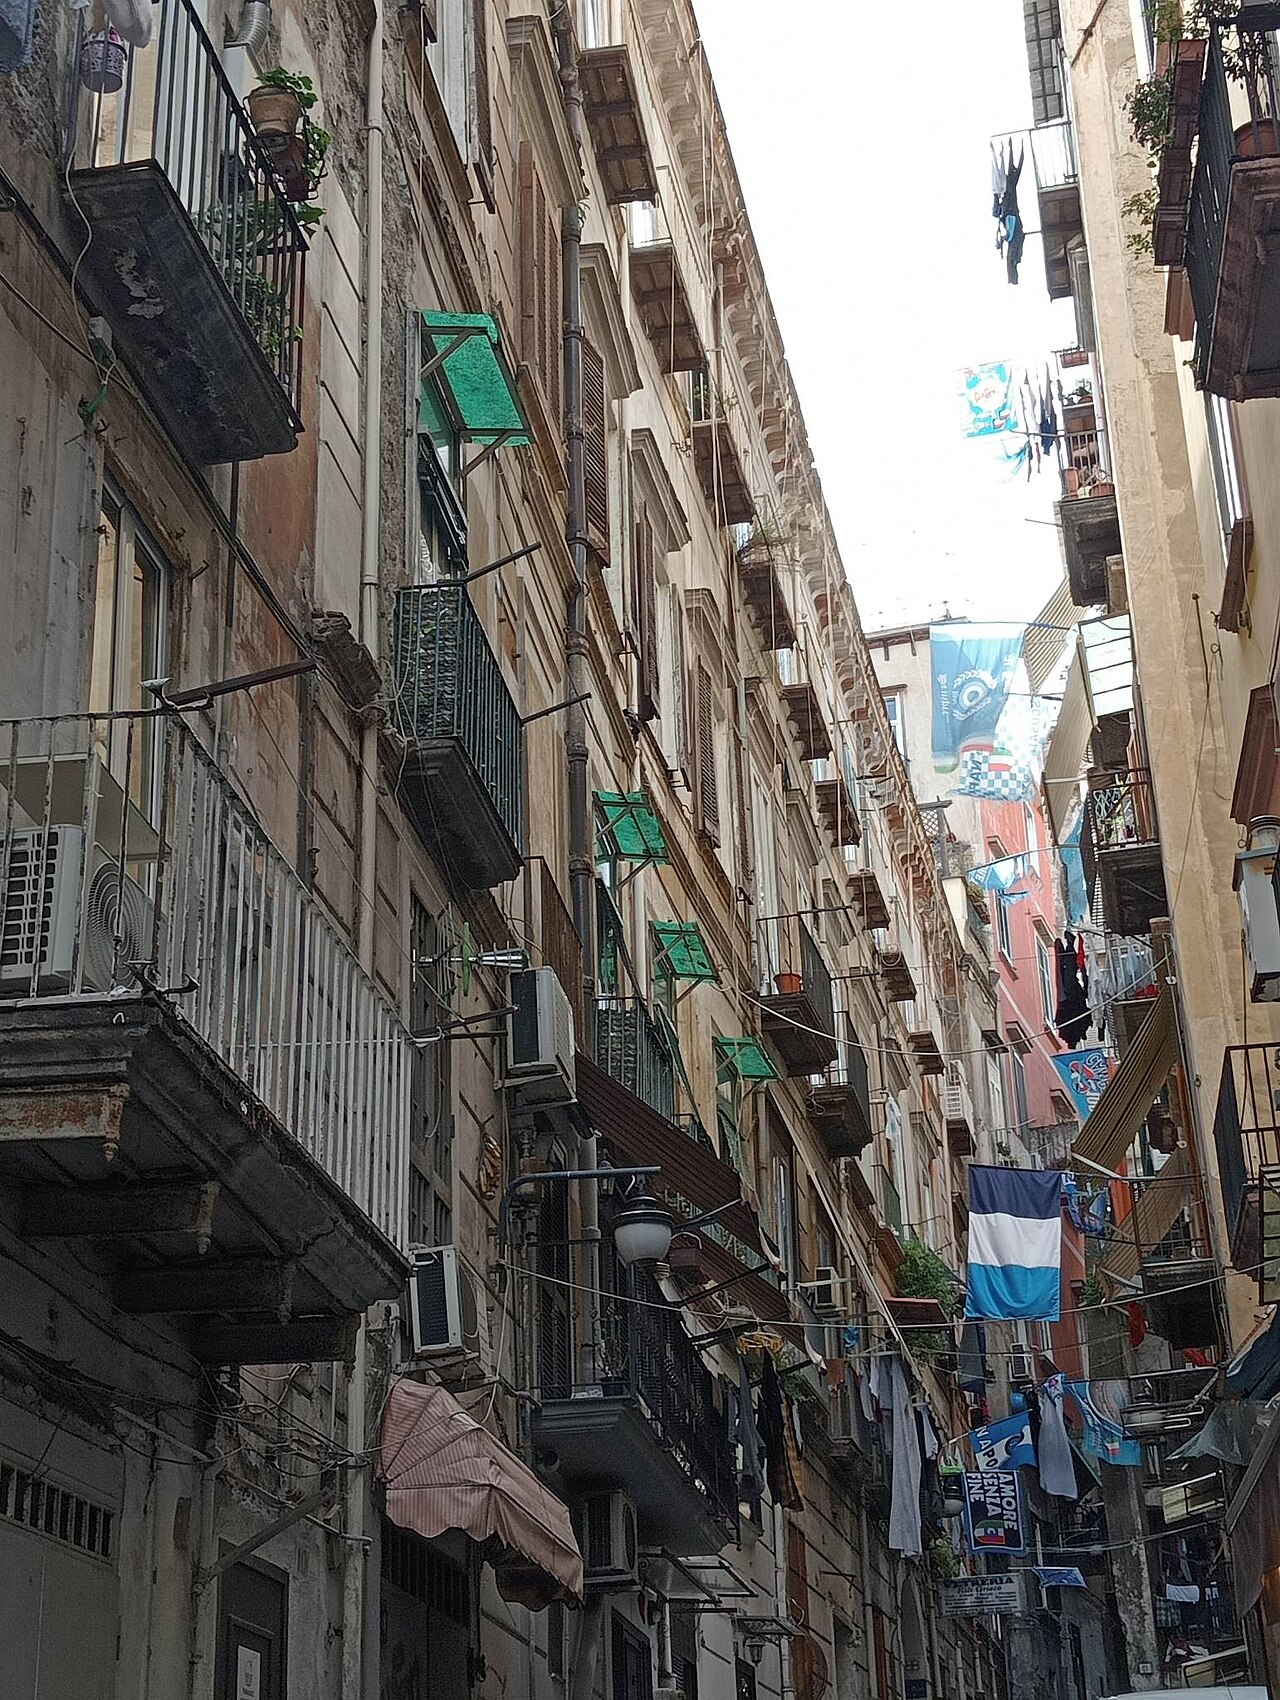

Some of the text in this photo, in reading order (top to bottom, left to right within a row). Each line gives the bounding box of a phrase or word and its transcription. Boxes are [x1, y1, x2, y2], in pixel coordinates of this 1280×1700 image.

[966, 1472, 985, 1503] FINE
[982, 1473, 1002, 1517] SENZA
[998, 1473, 1018, 1531] AMORE
